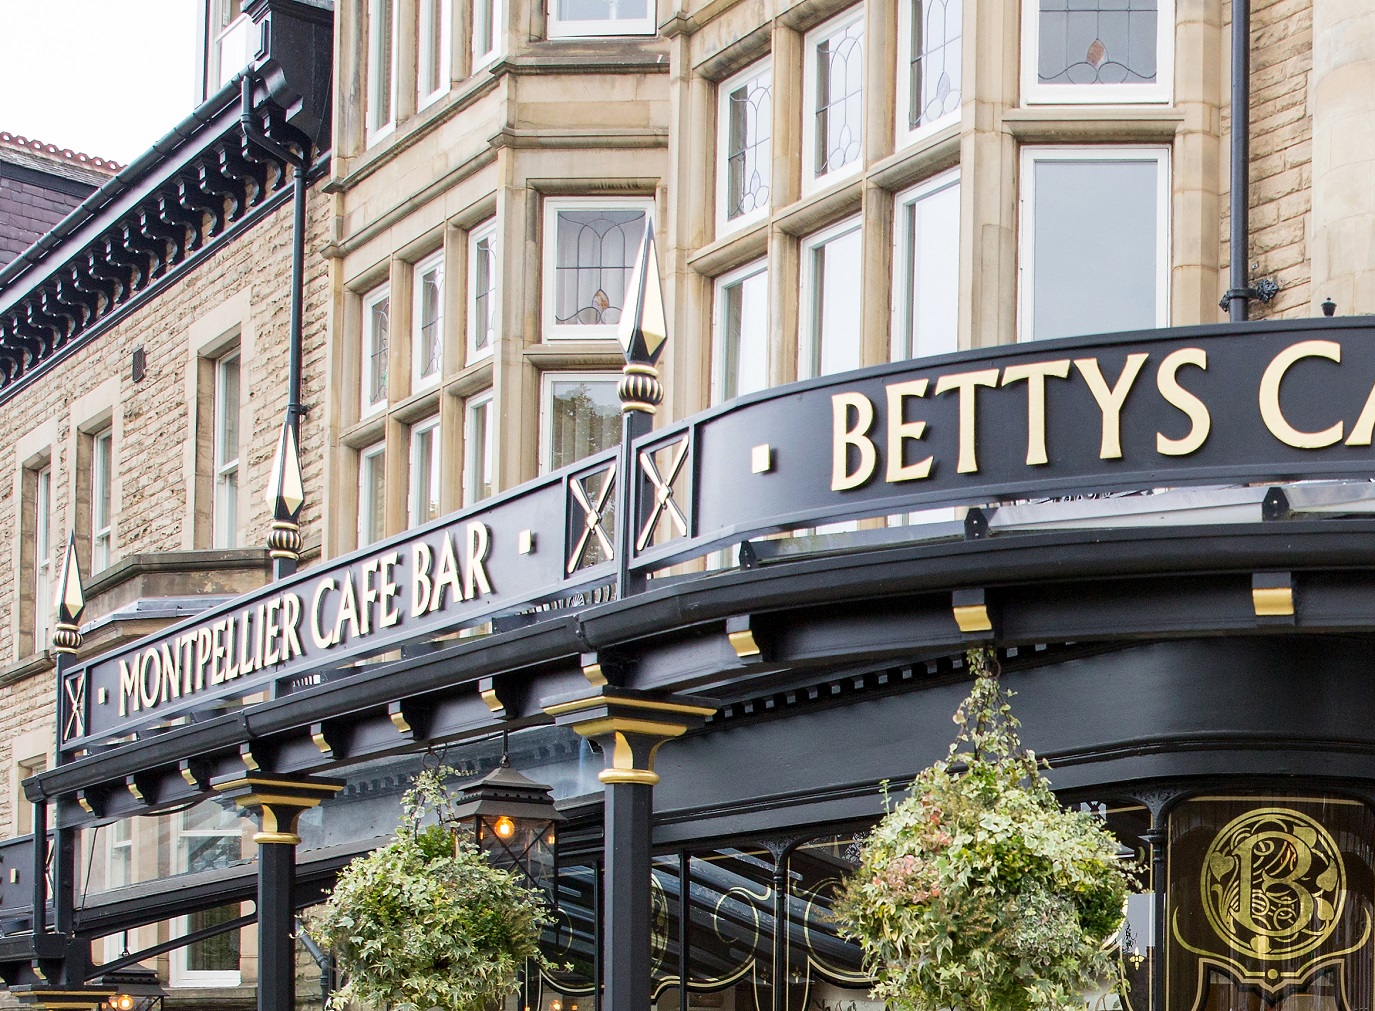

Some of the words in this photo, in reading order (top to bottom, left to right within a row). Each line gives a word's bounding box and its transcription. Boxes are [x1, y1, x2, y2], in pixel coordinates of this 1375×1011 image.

[831, 347, 1211, 492] BETTYS
[118, 592, 302, 718] MONTPELLIER
[310, 551, 402, 650] CAFE
[410, 520, 493, 619] BAR
